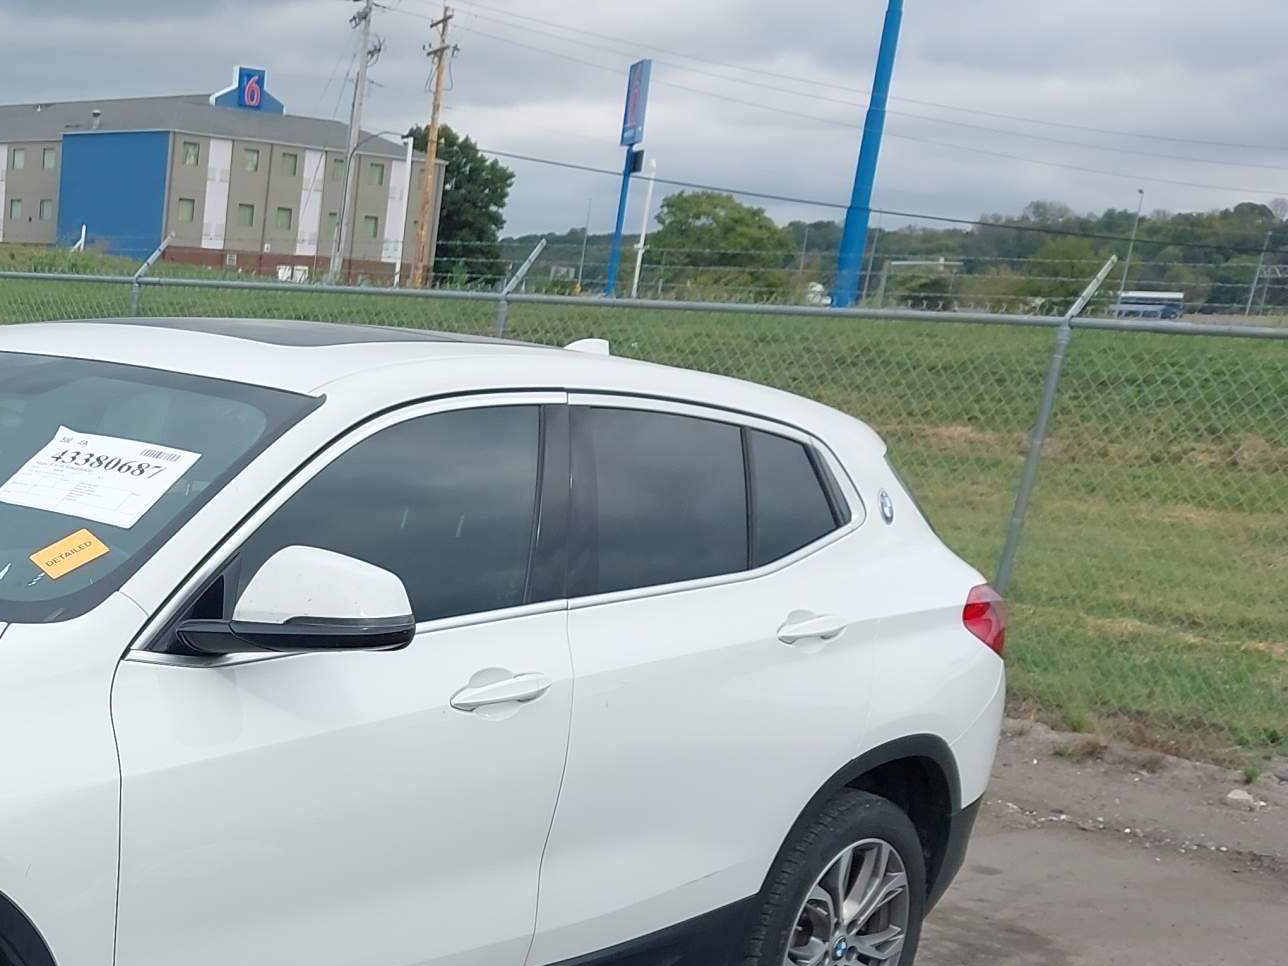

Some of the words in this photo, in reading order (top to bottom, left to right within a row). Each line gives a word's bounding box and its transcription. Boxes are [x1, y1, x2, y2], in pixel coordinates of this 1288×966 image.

[244, 75, 261, 107] 6
[50, 449, 167, 479] 43380687
[45, 540, 92, 567] DETAILED
